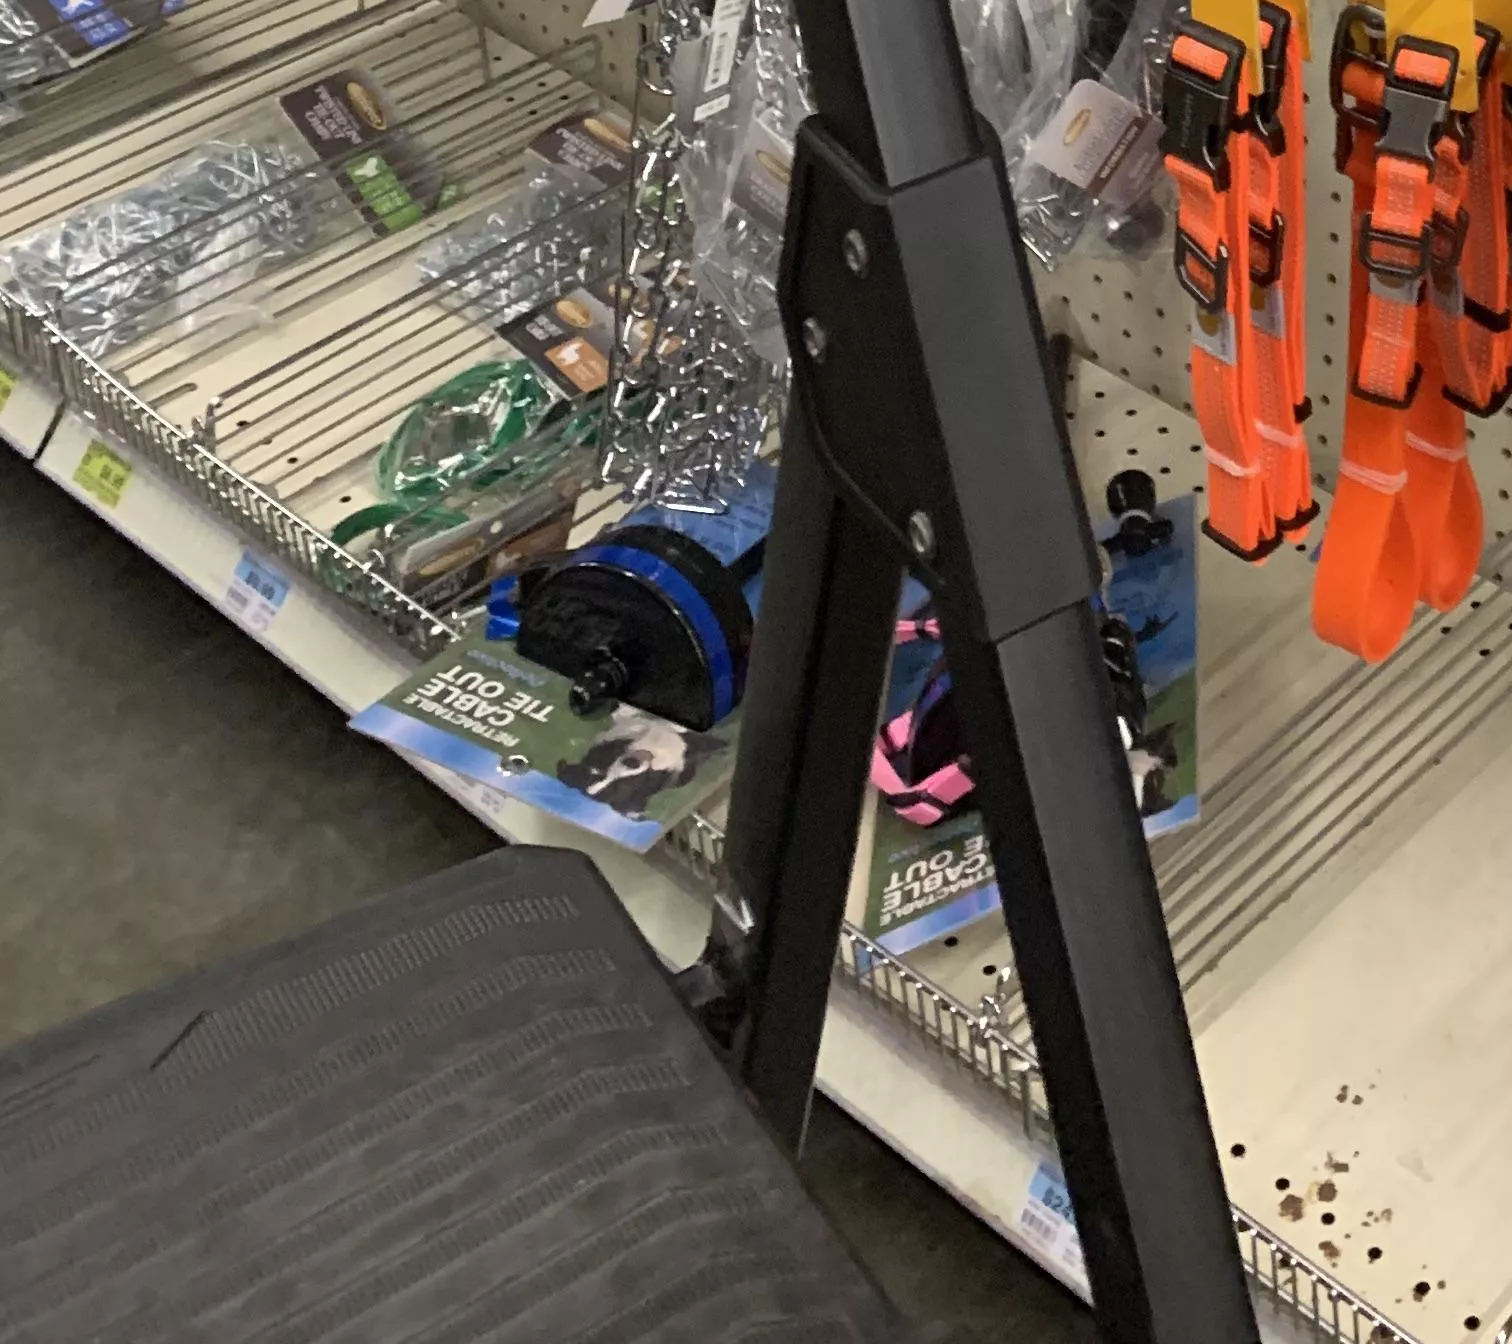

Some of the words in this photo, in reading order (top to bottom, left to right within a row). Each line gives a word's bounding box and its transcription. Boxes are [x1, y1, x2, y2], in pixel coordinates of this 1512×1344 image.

[416, 677, 516, 728] CABLE
[435, 664, 506, 700] OUT
[401, 691, 521, 748] RETRACTABLE
[502, 690, 555, 724] TIE
[880, 852, 989, 914] CABLE
[882, 849, 954, 894] OUT
